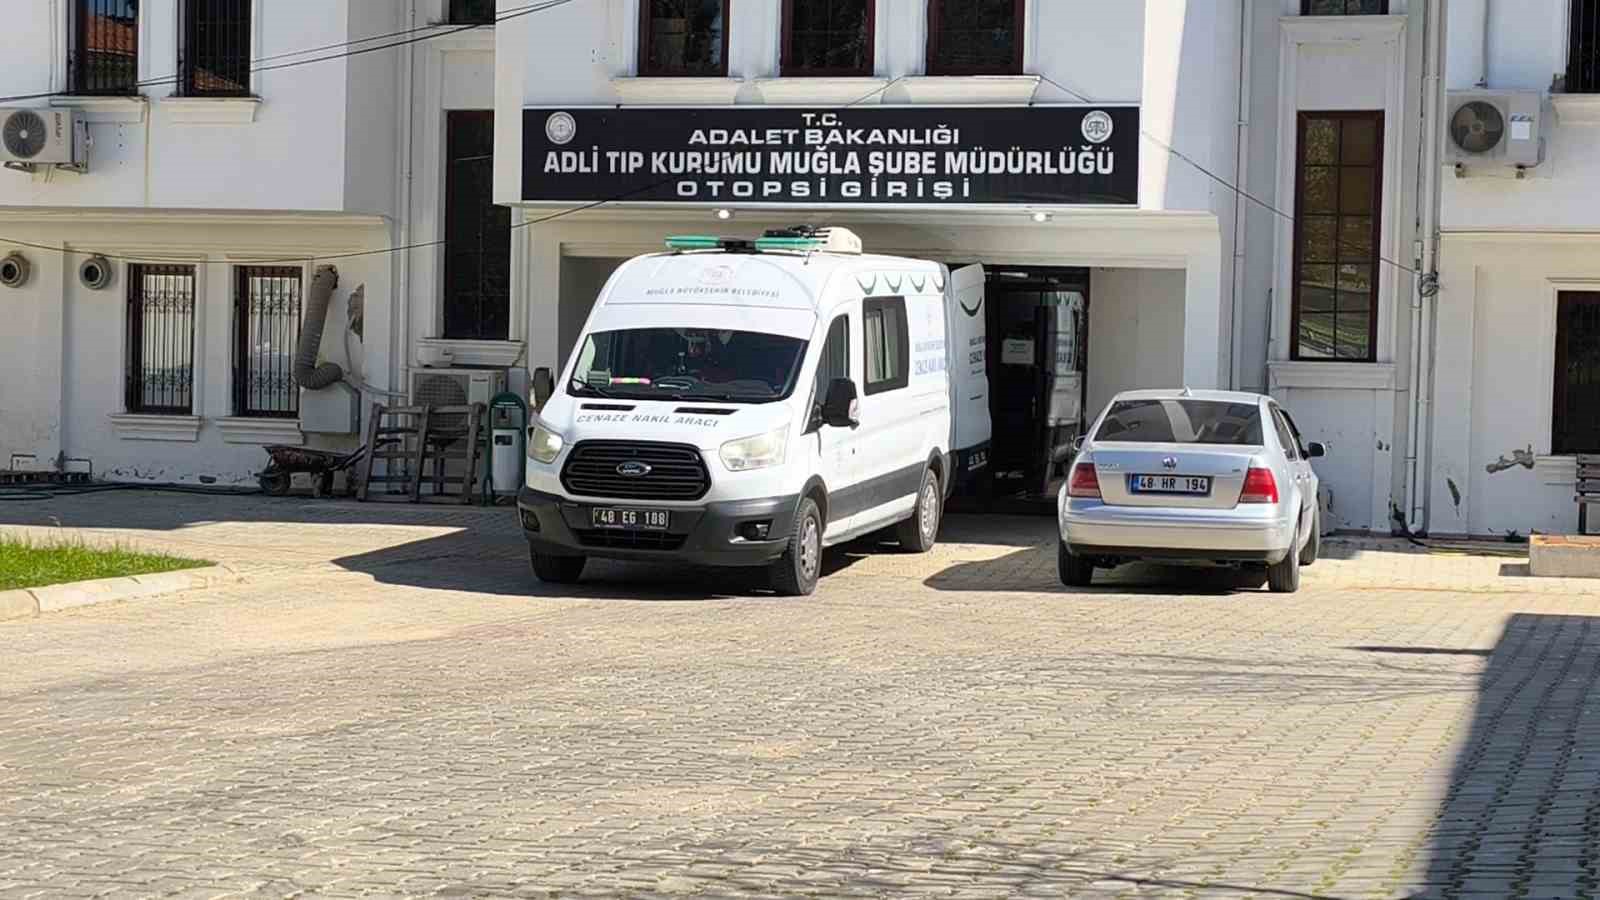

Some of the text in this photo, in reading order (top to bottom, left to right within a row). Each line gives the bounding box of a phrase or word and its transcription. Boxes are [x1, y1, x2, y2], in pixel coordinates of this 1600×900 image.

[802, 113, 842, 126] T.C.
[688, 124, 960, 145] ADALET BAKANLIĞI
[543, 145, 1114, 177] ADLİ TIP KURUMU MUĞLA ŞUBE MÜDÜRLÜĞÜ
[677, 177, 970, 199] OTOPSİ GİRİŞİ
[576, 414, 630, 424] CENAZE
[1140, 475, 1207, 490] 48 HR 194
[622, 510, 637, 525] EG
